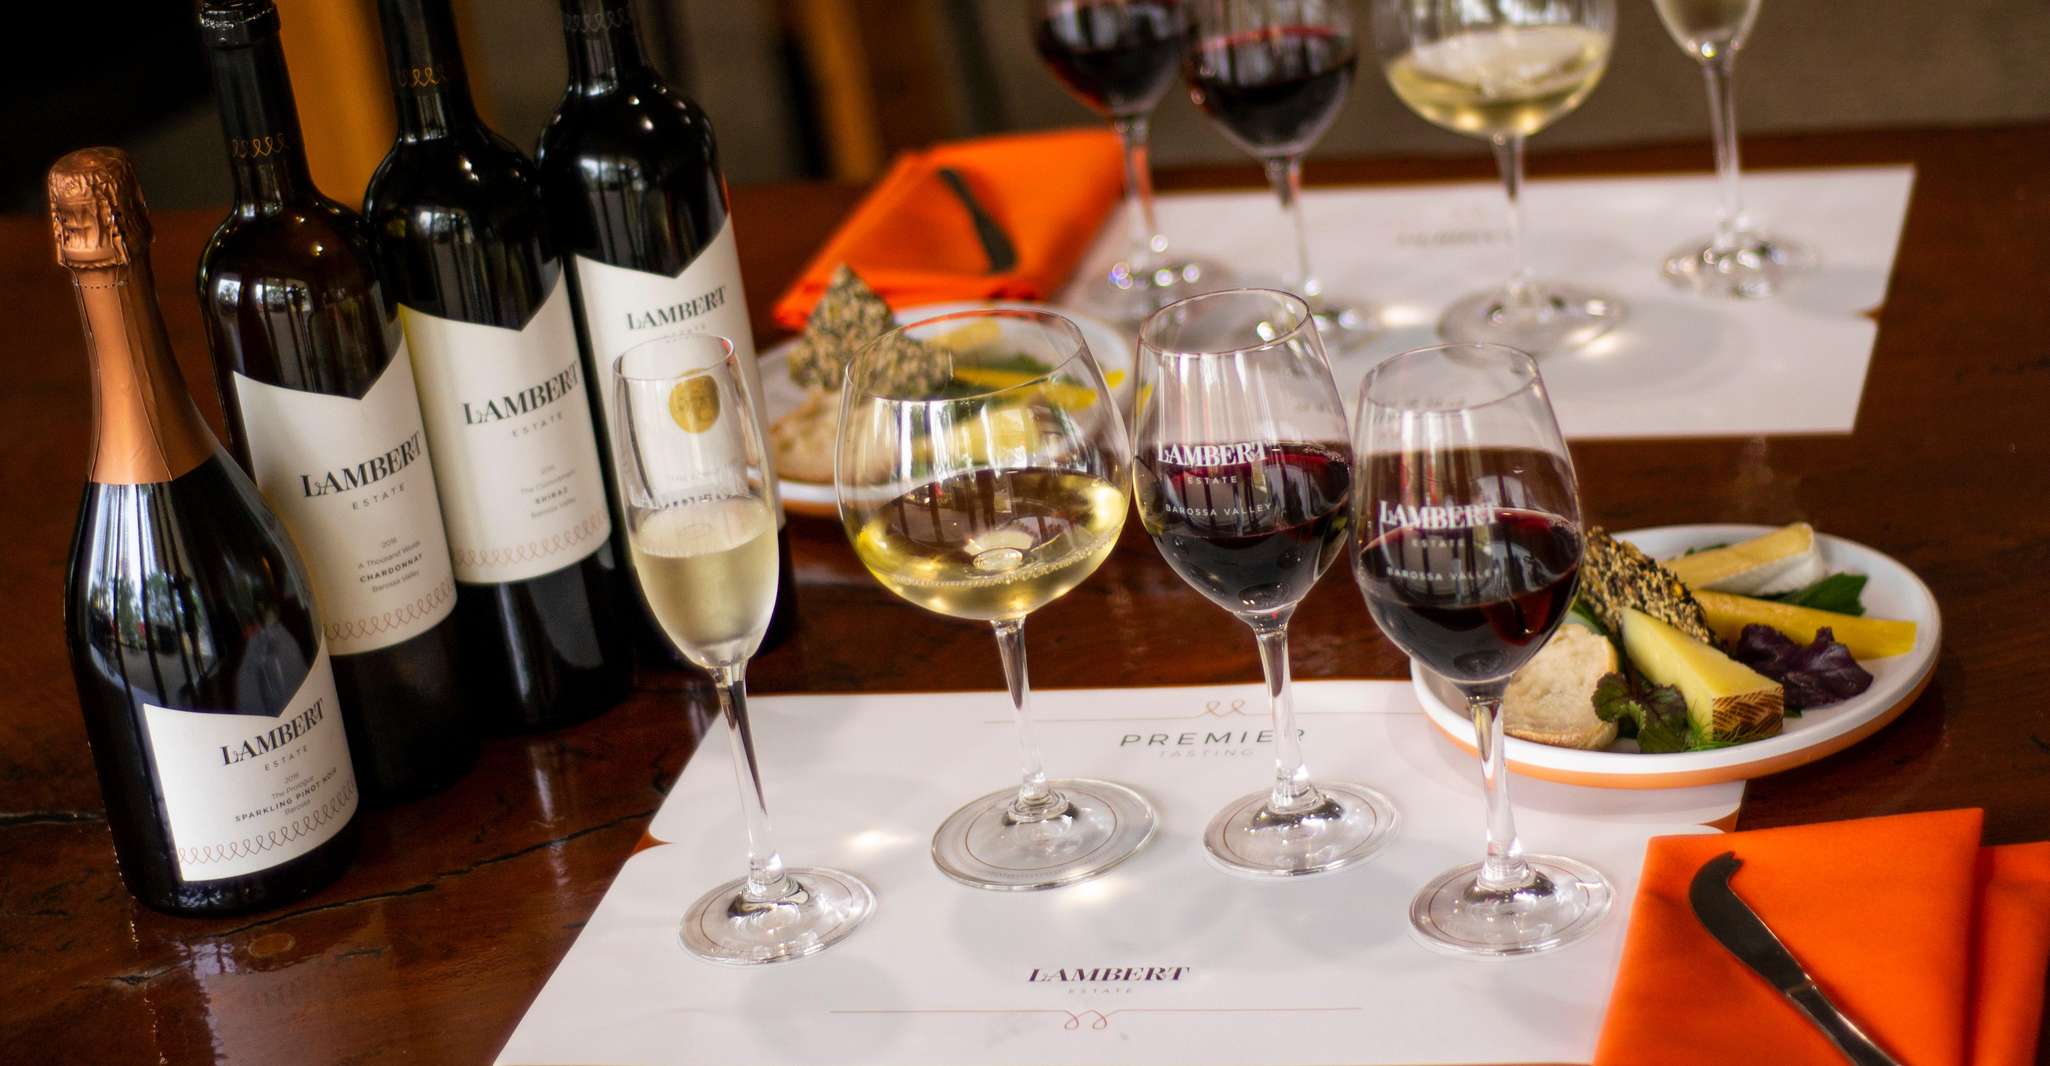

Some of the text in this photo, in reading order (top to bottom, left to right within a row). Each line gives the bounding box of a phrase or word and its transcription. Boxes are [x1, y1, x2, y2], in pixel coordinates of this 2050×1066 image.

[627, 285, 726, 330] LAMBERT
[463, 361, 578, 425] LAMBERT
[511, 411, 564, 437] ESTATE
[300, 430, 422, 497] LAMBERT
[1158, 440, 1269, 467] LAMBERT
[1188, 475, 1237, 485] ESTATE
[352, 481, 405, 511] ESTATE
[1165, 503, 1272, 517] BAROSSA VALLEY
[1380, 500, 1496, 529] LAMBERT
[359, 552, 423, 583] CHARDONNAY
[1386, 566, 1443, 580] BAROSSA
[219, 697, 325, 766] LAMBERT
[264, 745, 309, 772] ESTATE
[234, 798, 293, 822] SPARKLING
[296, 782, 321, 800] PINOT
[1028, 966, 1191, 983] LAMBERT
